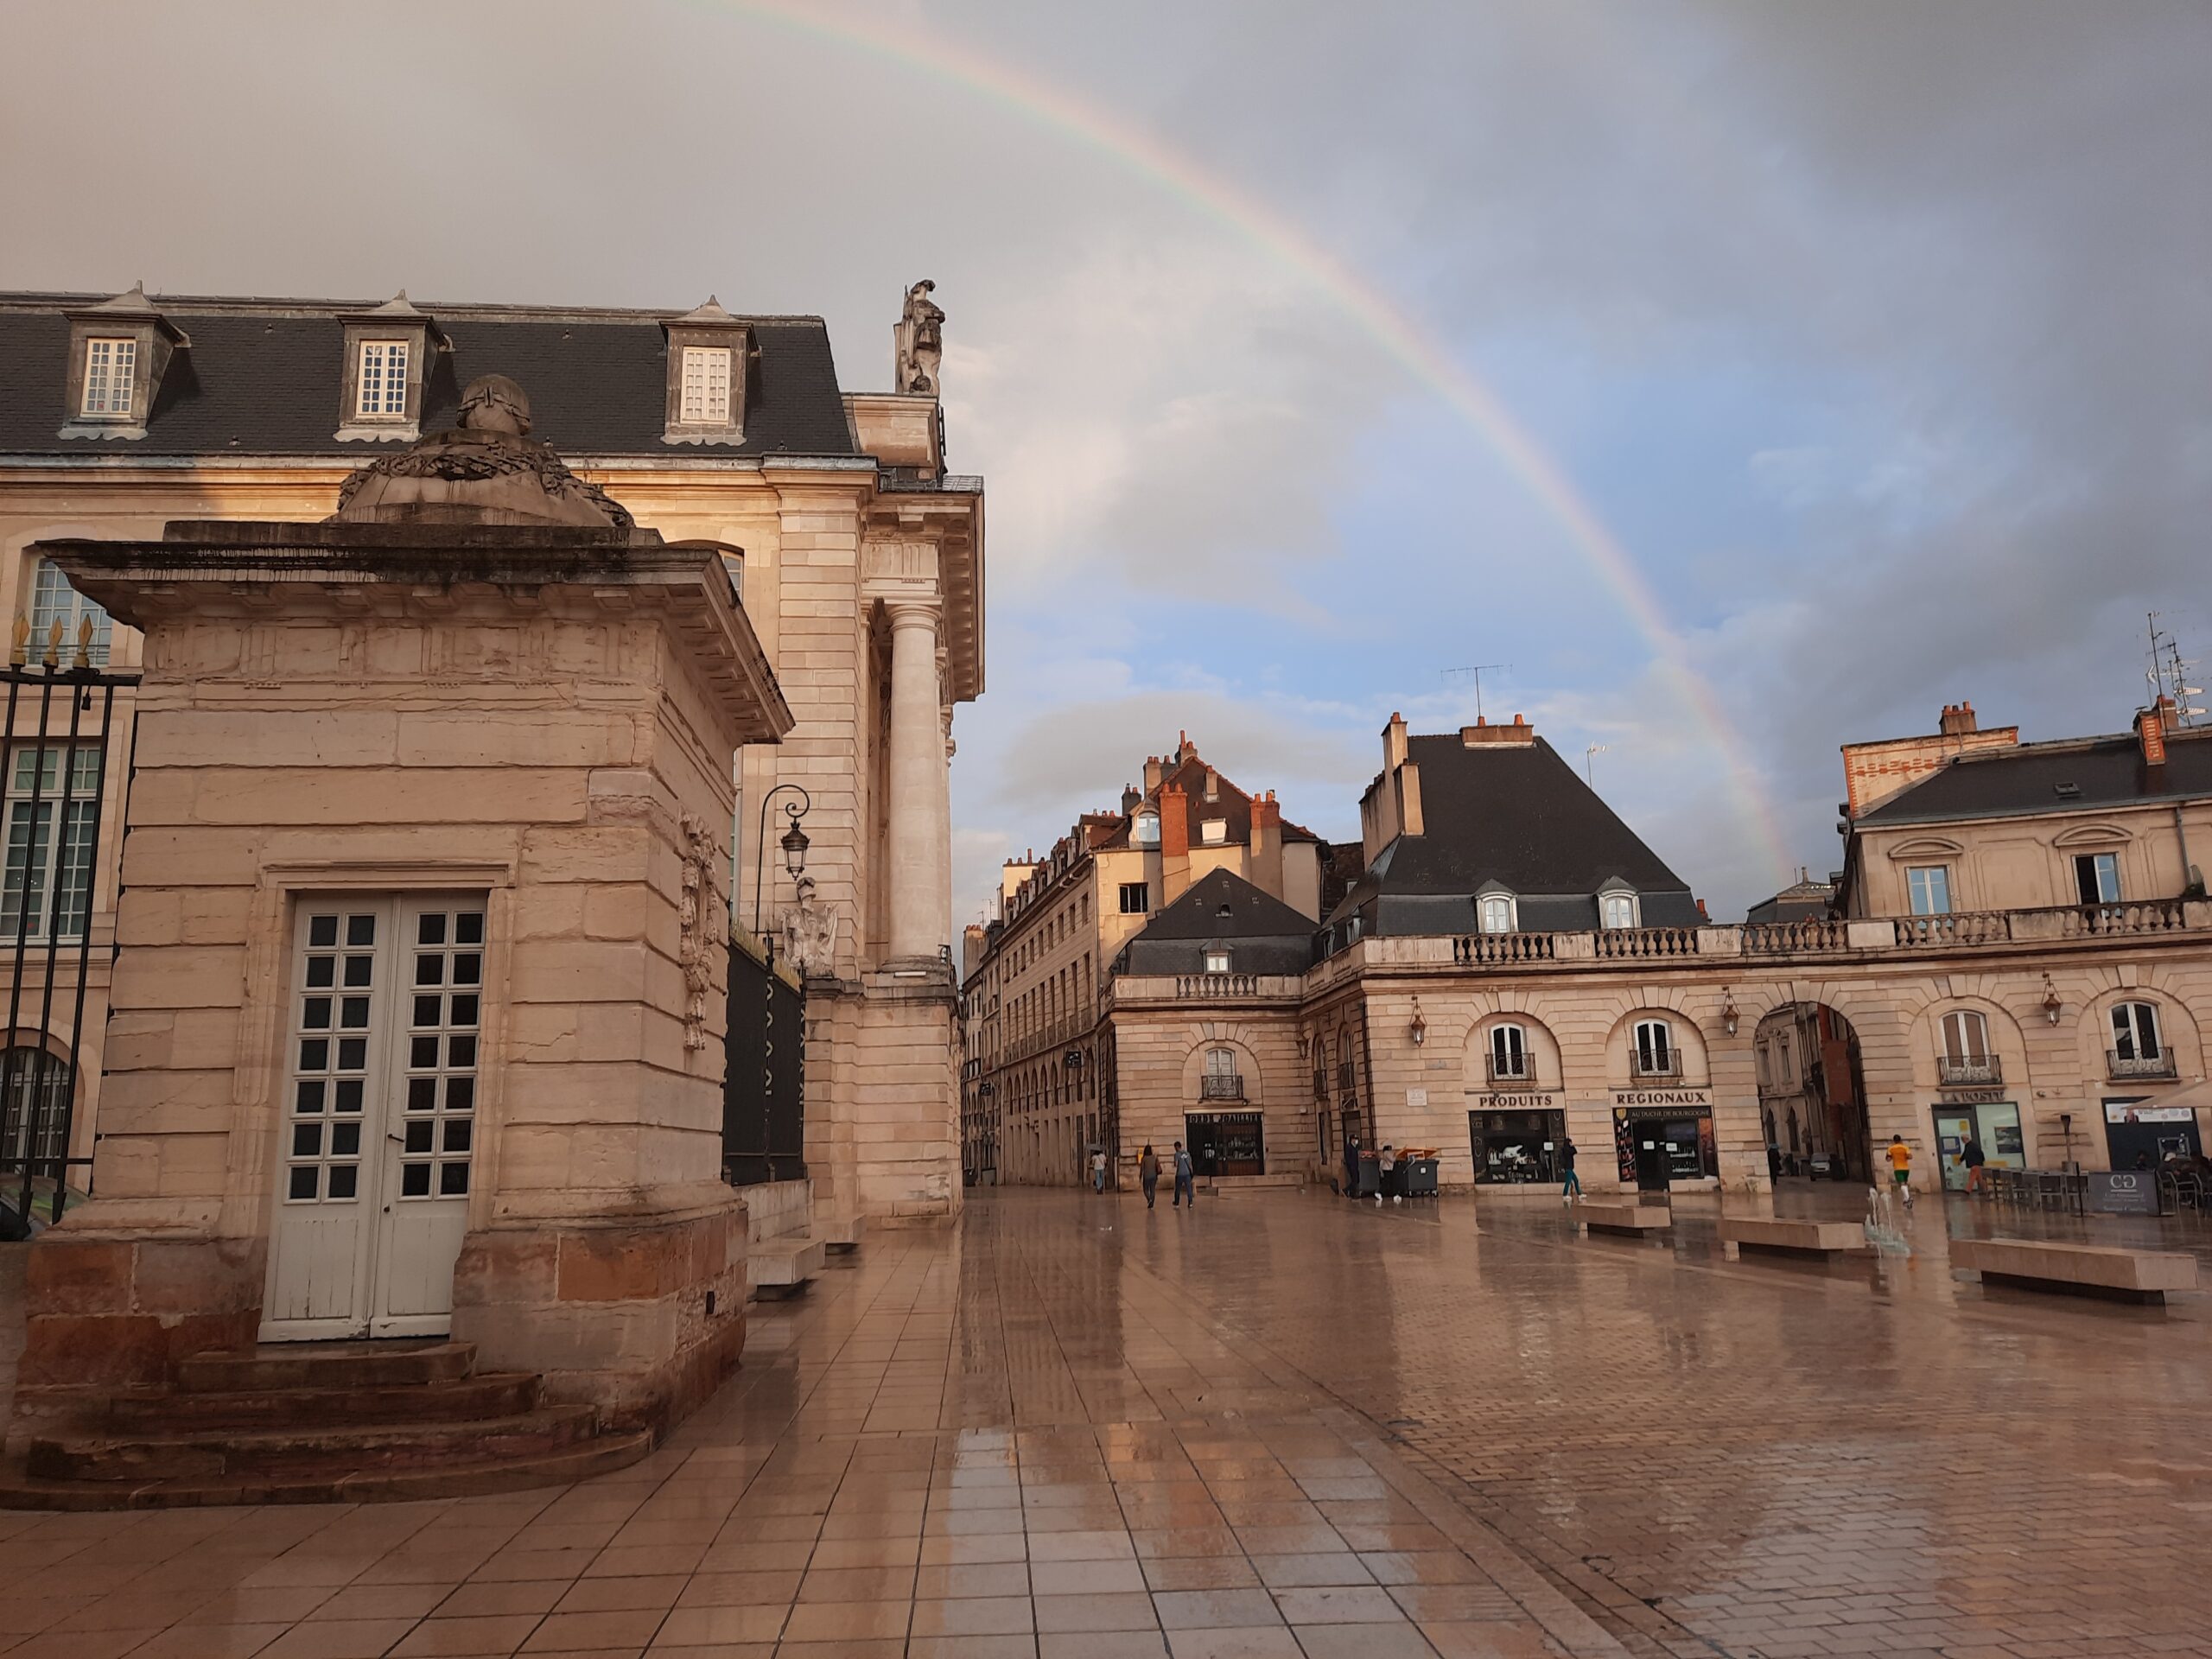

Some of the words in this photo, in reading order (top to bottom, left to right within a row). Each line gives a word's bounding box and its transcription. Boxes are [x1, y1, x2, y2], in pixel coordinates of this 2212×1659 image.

[1479, 1095, 1552, 1107] PRODUITS
[1617, 1092, 1707, 1104] REGIONAUX
[1961, 1090, 2005, 1103] POSTE
